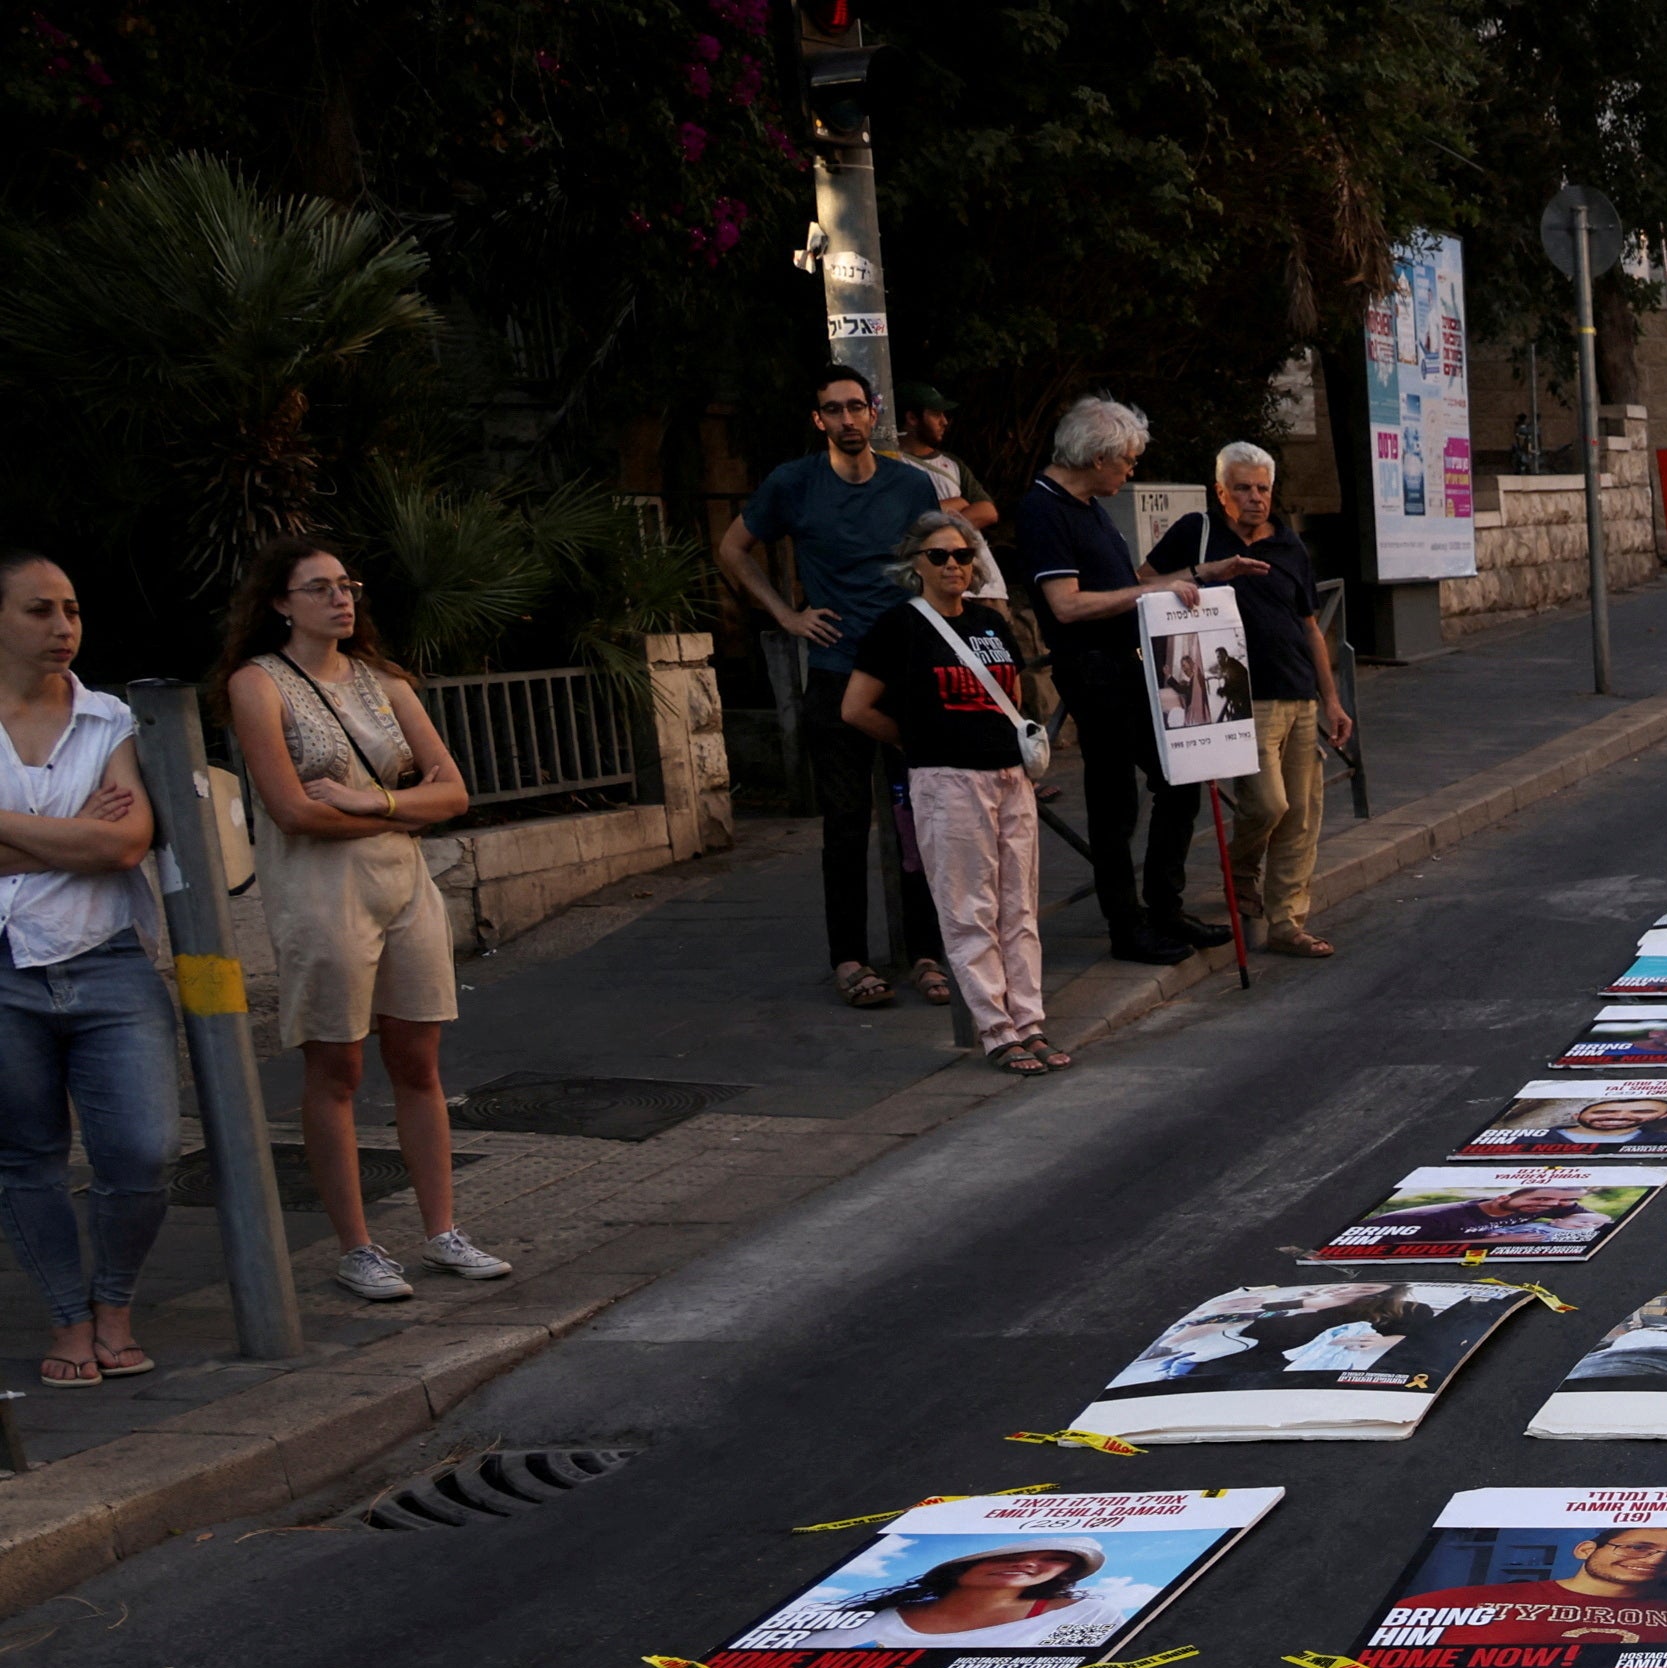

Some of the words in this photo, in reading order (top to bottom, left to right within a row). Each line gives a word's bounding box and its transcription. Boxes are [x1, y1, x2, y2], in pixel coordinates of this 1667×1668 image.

[1479, 1129, 1550, 1137] BRING
[1341, 1225, 1422, 1236] BRING
[1328, 1235, 1384, 1246] HIM
[984, 1508, 1041, 1520] EMILY
[1042, 1507, 1104, 1519] TEHILA
[1106, 1504, 1188, 1518] DAMARI
[1565, 1501, 1627, 1512] TAMIR
[1612, 1511, 1652, 1524] (19)
[758, 1610, 877, 1631] BRING
[1381, 1607, 1497, 1627] BRING
[728, 1630, 812, 1650] HER
[1367, 1627, 1446, 1647] HIM
[1466, 1644, 1582, 1668] NOW!
